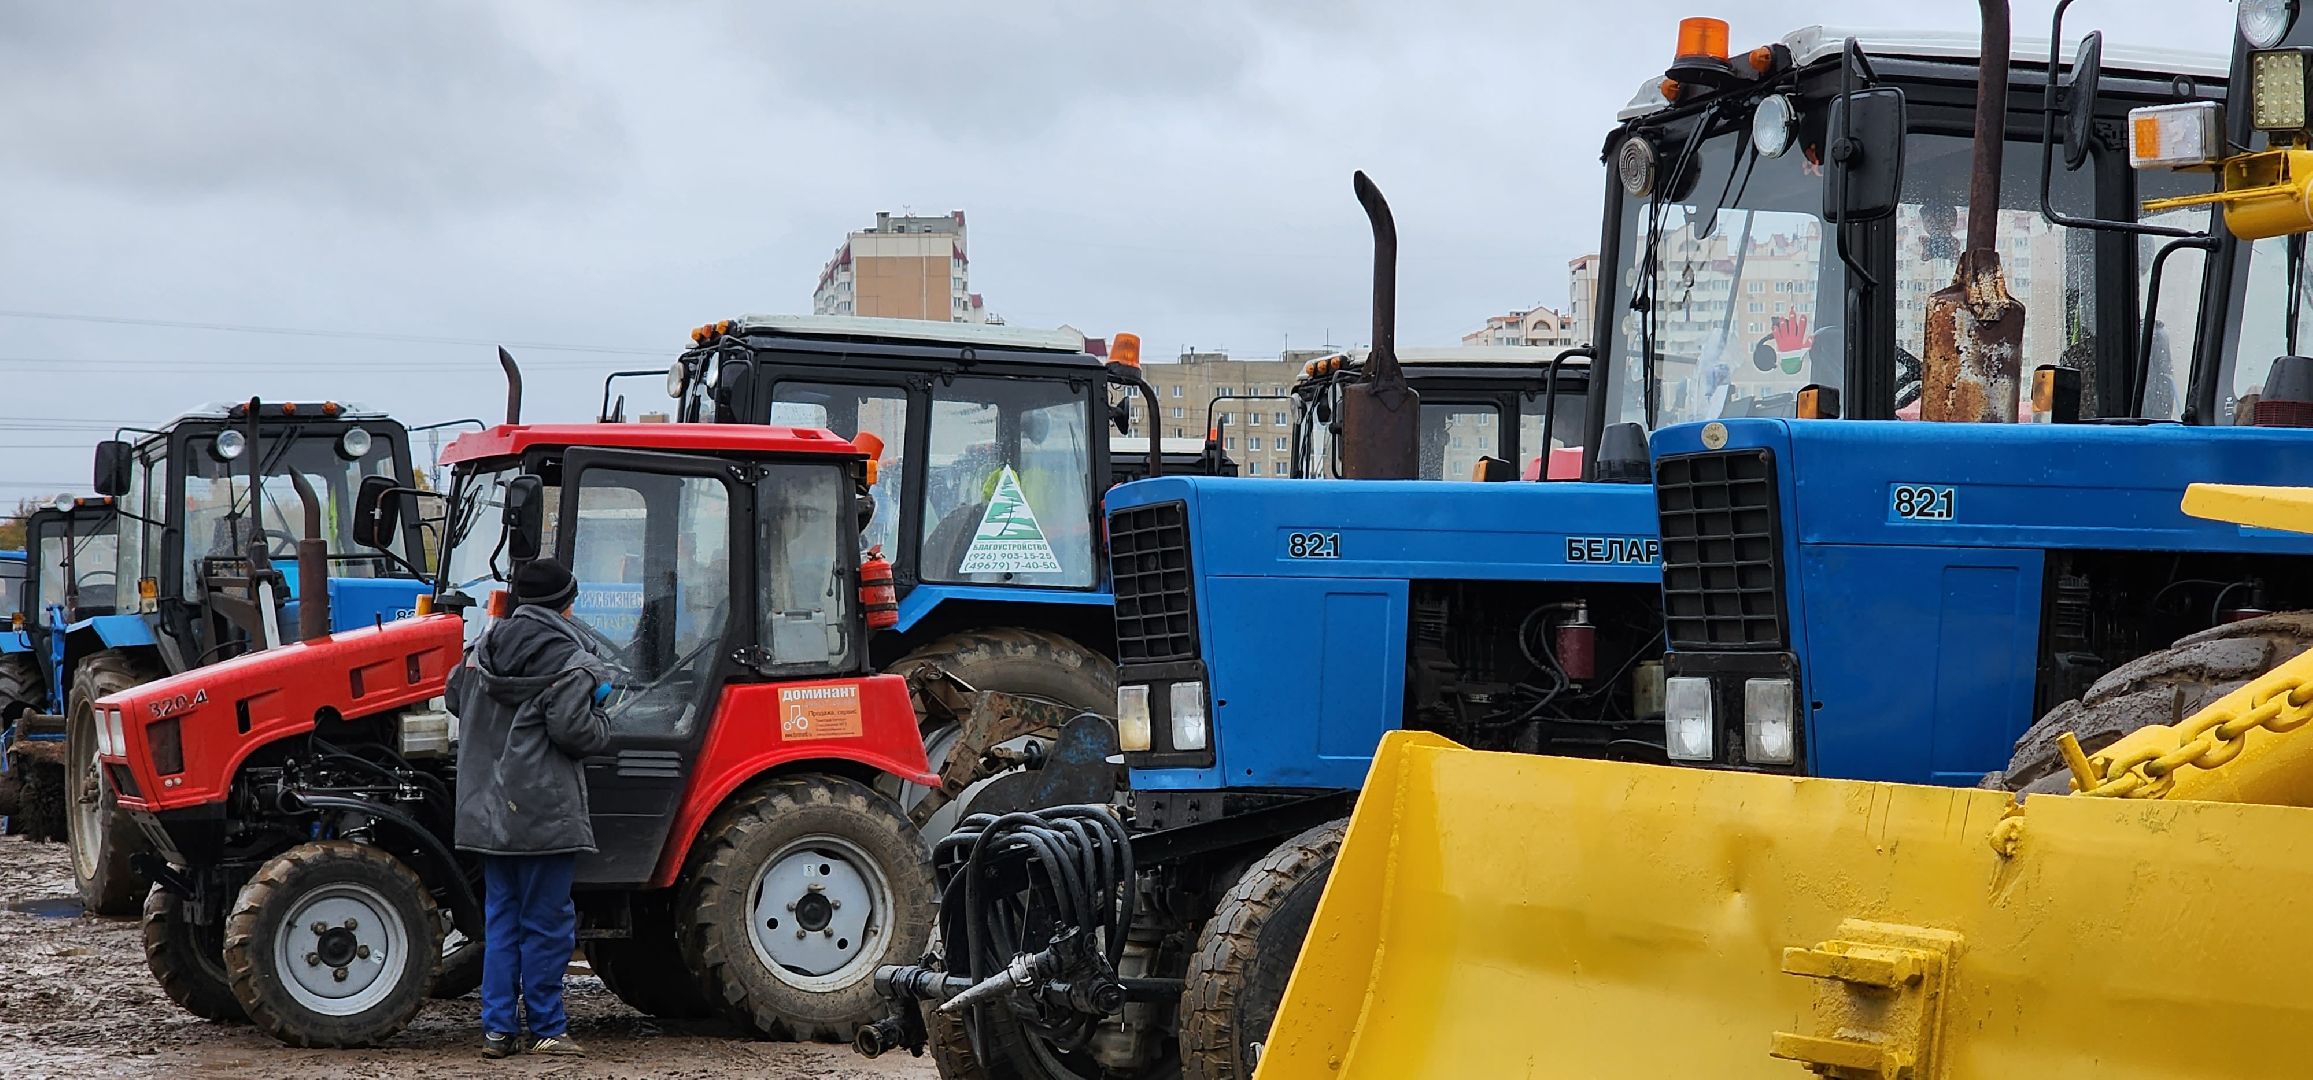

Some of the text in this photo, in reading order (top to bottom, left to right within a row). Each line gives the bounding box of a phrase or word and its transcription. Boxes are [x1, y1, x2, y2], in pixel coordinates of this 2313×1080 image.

[1894, 486, 1954, 520] 82.1
[972, 543, 1048, 551] БЛАГОУСТРОЙСТВО
[1289, 532, 1340, 558] 82.1
[1566, 536, 1659, 564] БЕЛАР
[968, 552, 1052, 561] (926) 903-15-25
[964, 561, 1057, 571] (49679) 7-40-50
